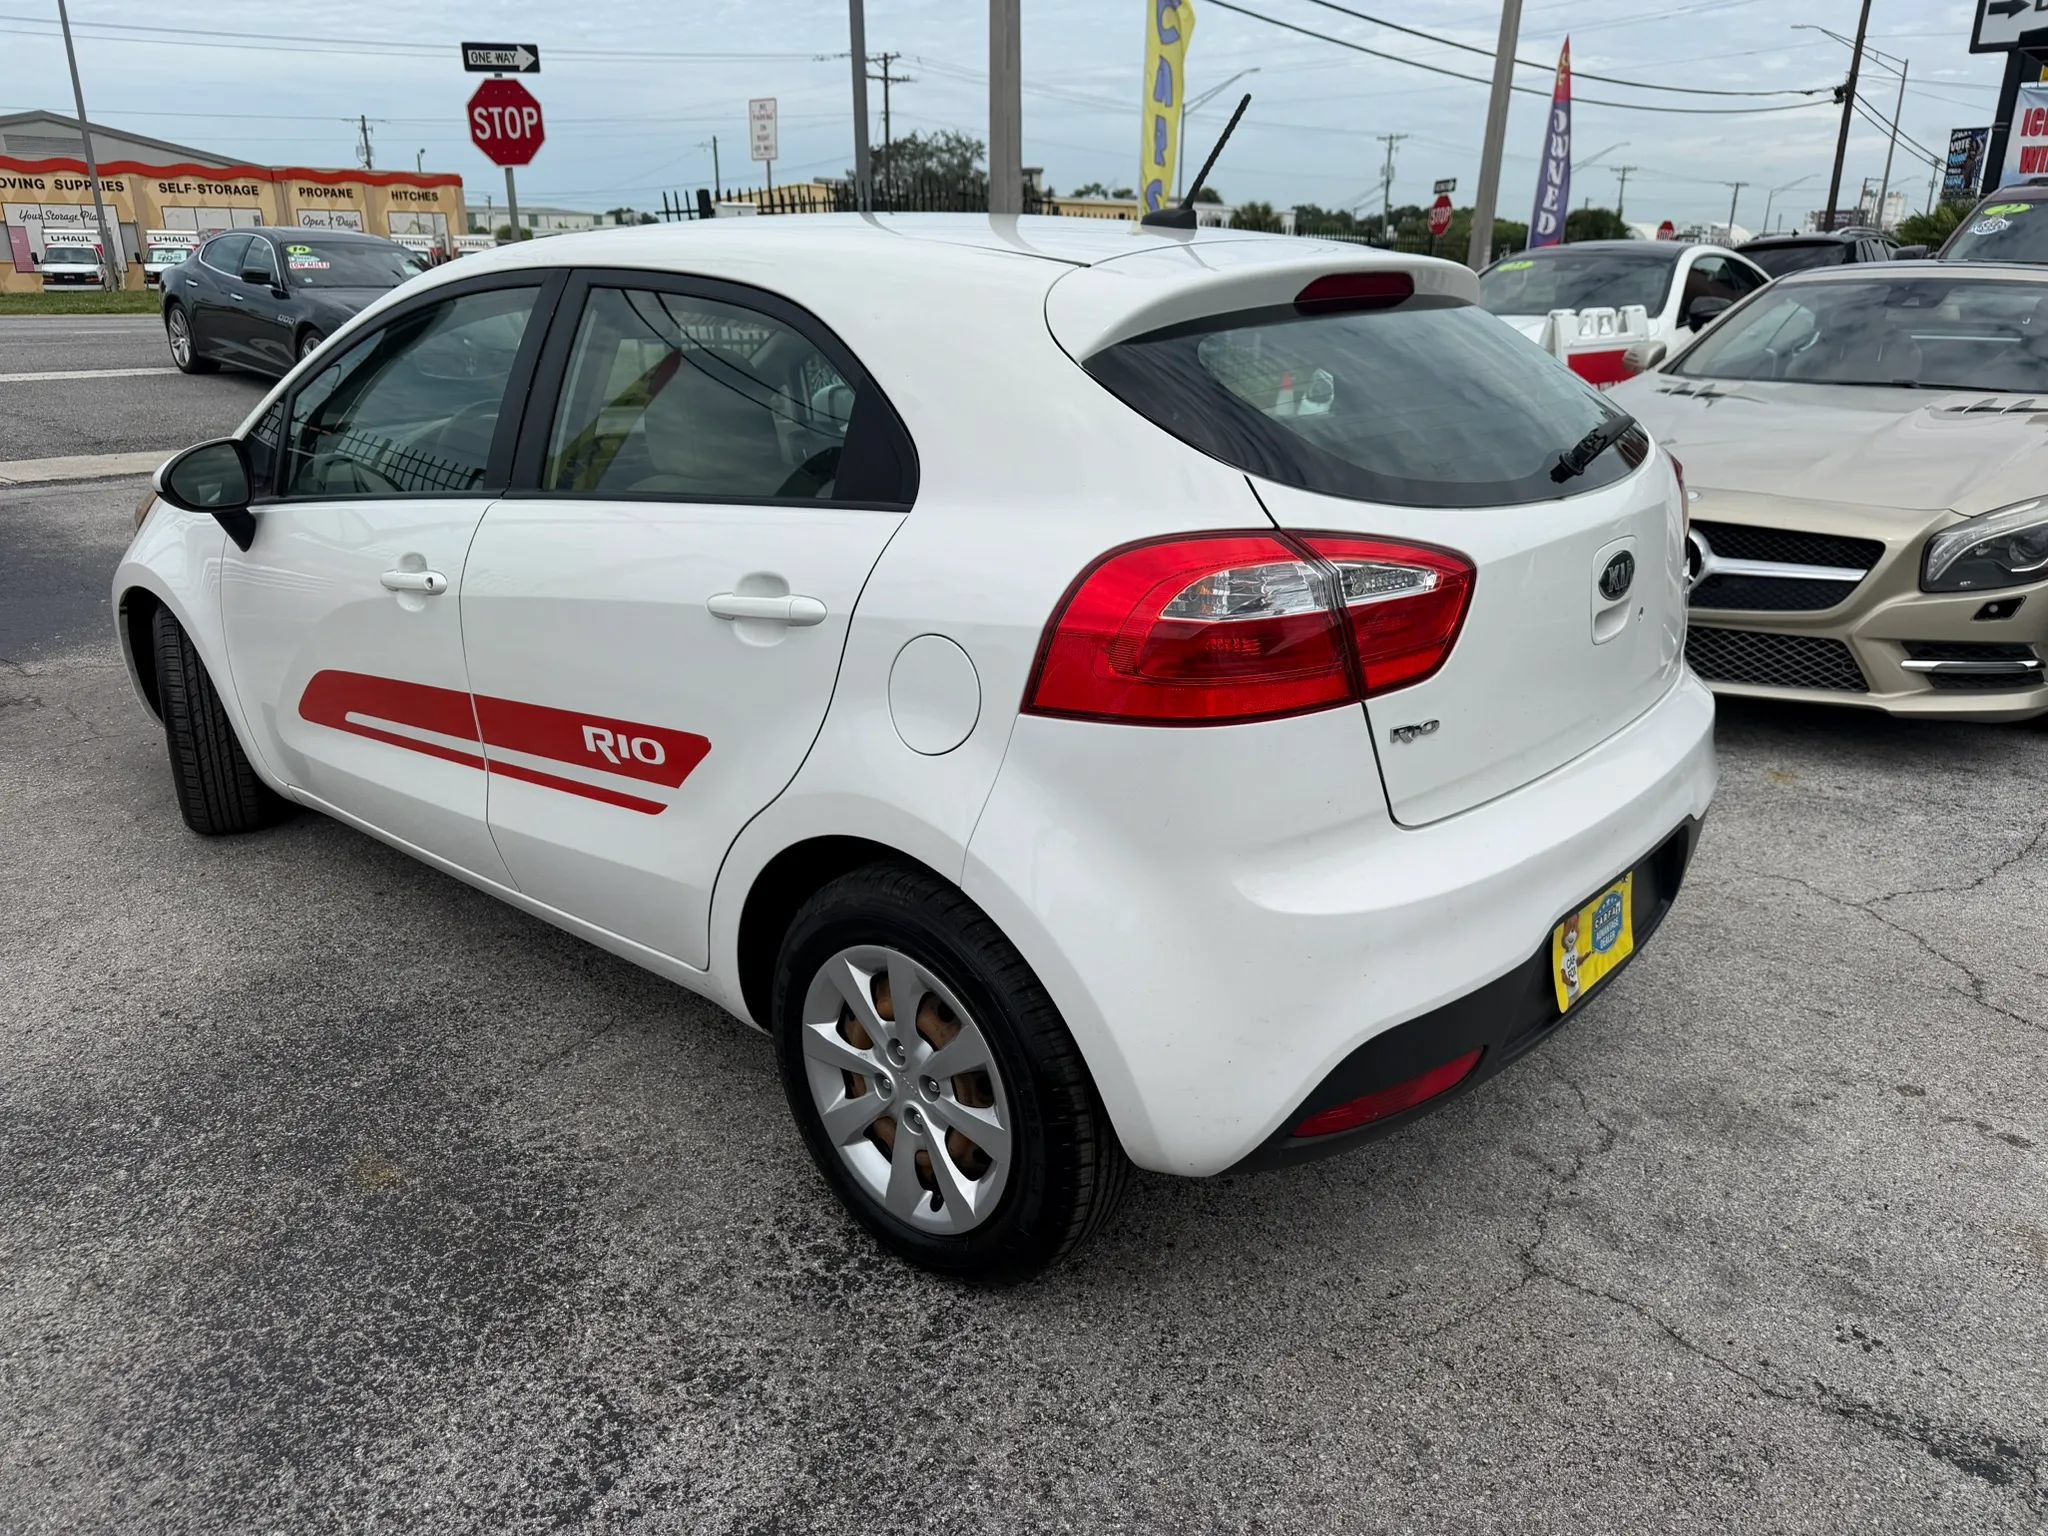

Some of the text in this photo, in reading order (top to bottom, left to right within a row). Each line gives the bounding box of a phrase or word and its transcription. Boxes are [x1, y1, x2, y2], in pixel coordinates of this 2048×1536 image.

[471, 51, 516, 64] ONE WAY
[473, 106, 538, 140] STOP
[2019, 146, 2048, 174] WI
[54, 179, 125, 192] SUPPIES
[298, 187, 354, 199] PROPANE
[391, 190, 439, 201] HITCHES
[19, 209, 43, 222] Your
[44, 210, 80, 223] Storage
[302, 214, 326, 228] Open
[335, 215, 358, 229] Days
[1430, 206, 1452, 226] STOP
[582, 724, 666, 766] RIO
